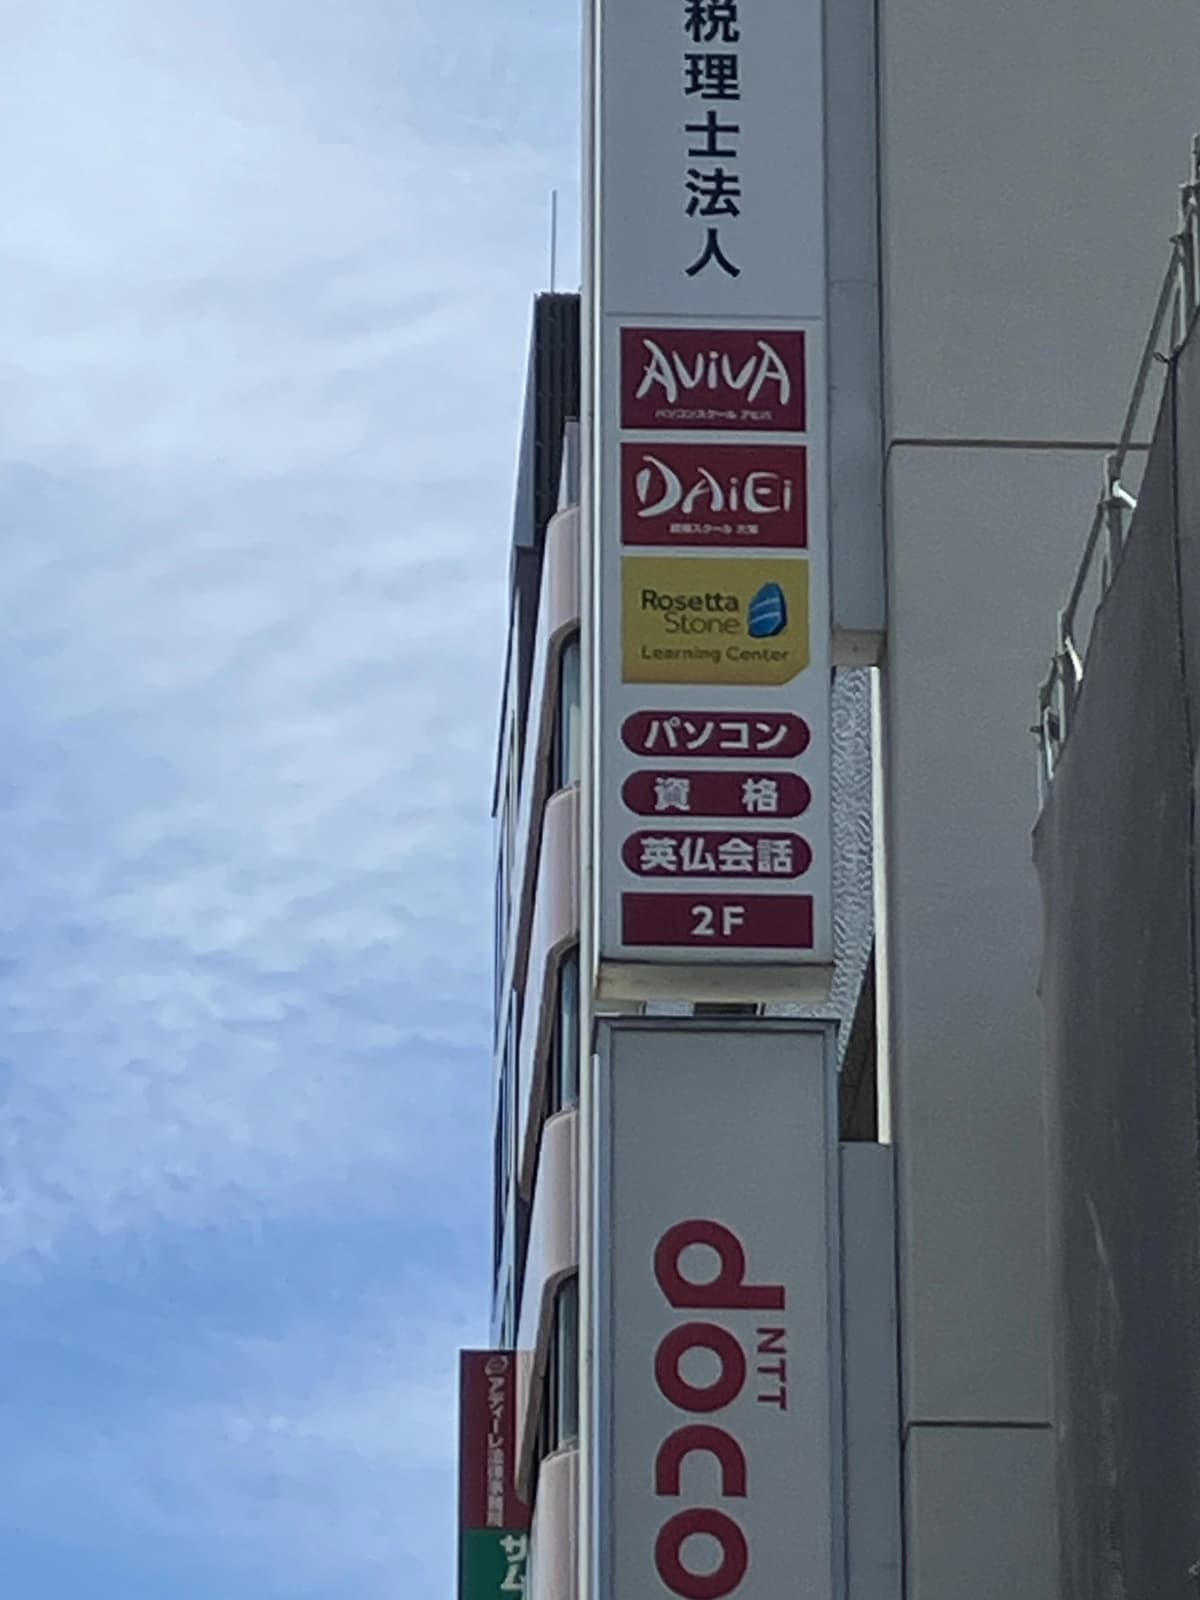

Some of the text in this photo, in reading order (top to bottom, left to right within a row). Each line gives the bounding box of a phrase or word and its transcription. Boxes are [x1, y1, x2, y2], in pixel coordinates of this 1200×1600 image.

[684, 0, 741, 278] 税理士法人
[641, 589, 740, 612] Rosetta
[664, 611, 740, 635] Stone
[641, 645, 790, 664] Learning Center
[644, 715, 788, 751] パソコン
[640, 836, 793, 873] 英仏会話
[690, 904, 746, 936] 2F
[756, 1327, 788, 1411] NTT
